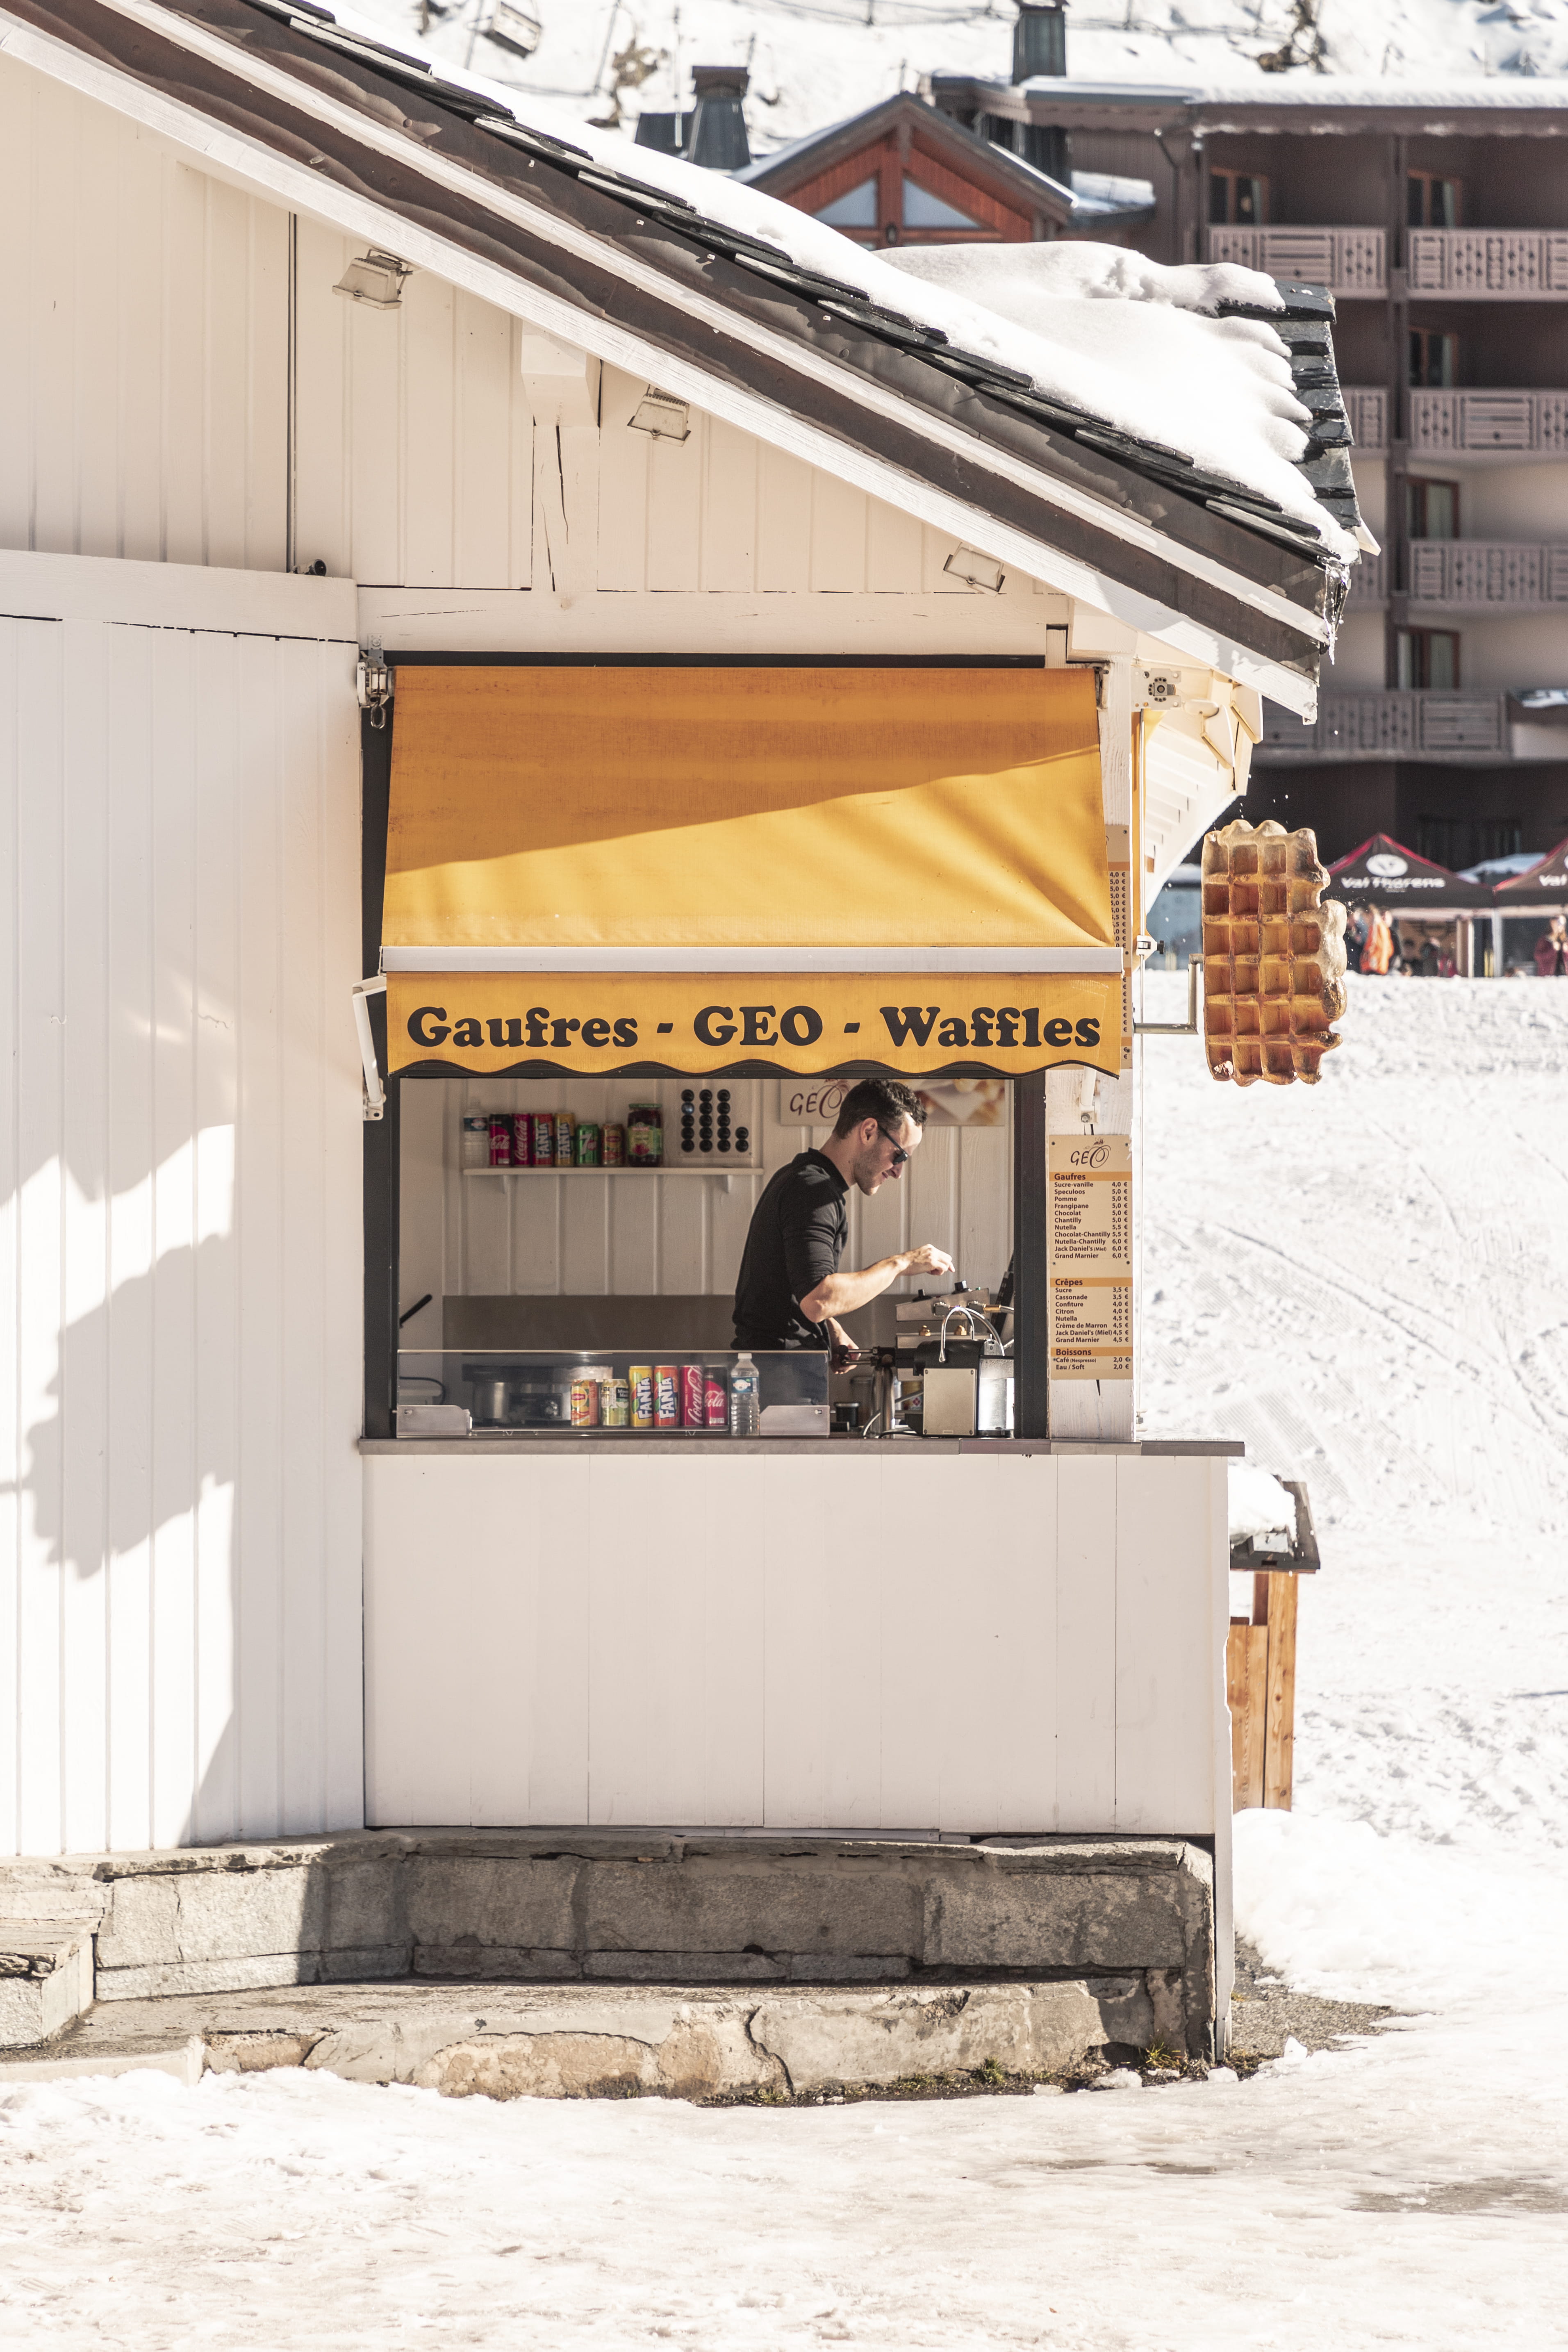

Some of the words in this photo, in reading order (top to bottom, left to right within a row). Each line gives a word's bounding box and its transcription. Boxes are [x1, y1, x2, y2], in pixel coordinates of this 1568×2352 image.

[407, 1006, 637, 1047] Gaufres
[694, 1005, 823, 1046] GEO
[879, 1006, 1100, 1047] Waffles
[790, 1085, 842, 1118] GEO
[536, 1123, 550, 1159] FANTA
[558, 1123, 570, 1159] FANTA
[1070, 1145, 1111, 1168] GEO
[637, 1377, 653, 1419] FANTA
[658, 1377, 675, 1419] FANTA
